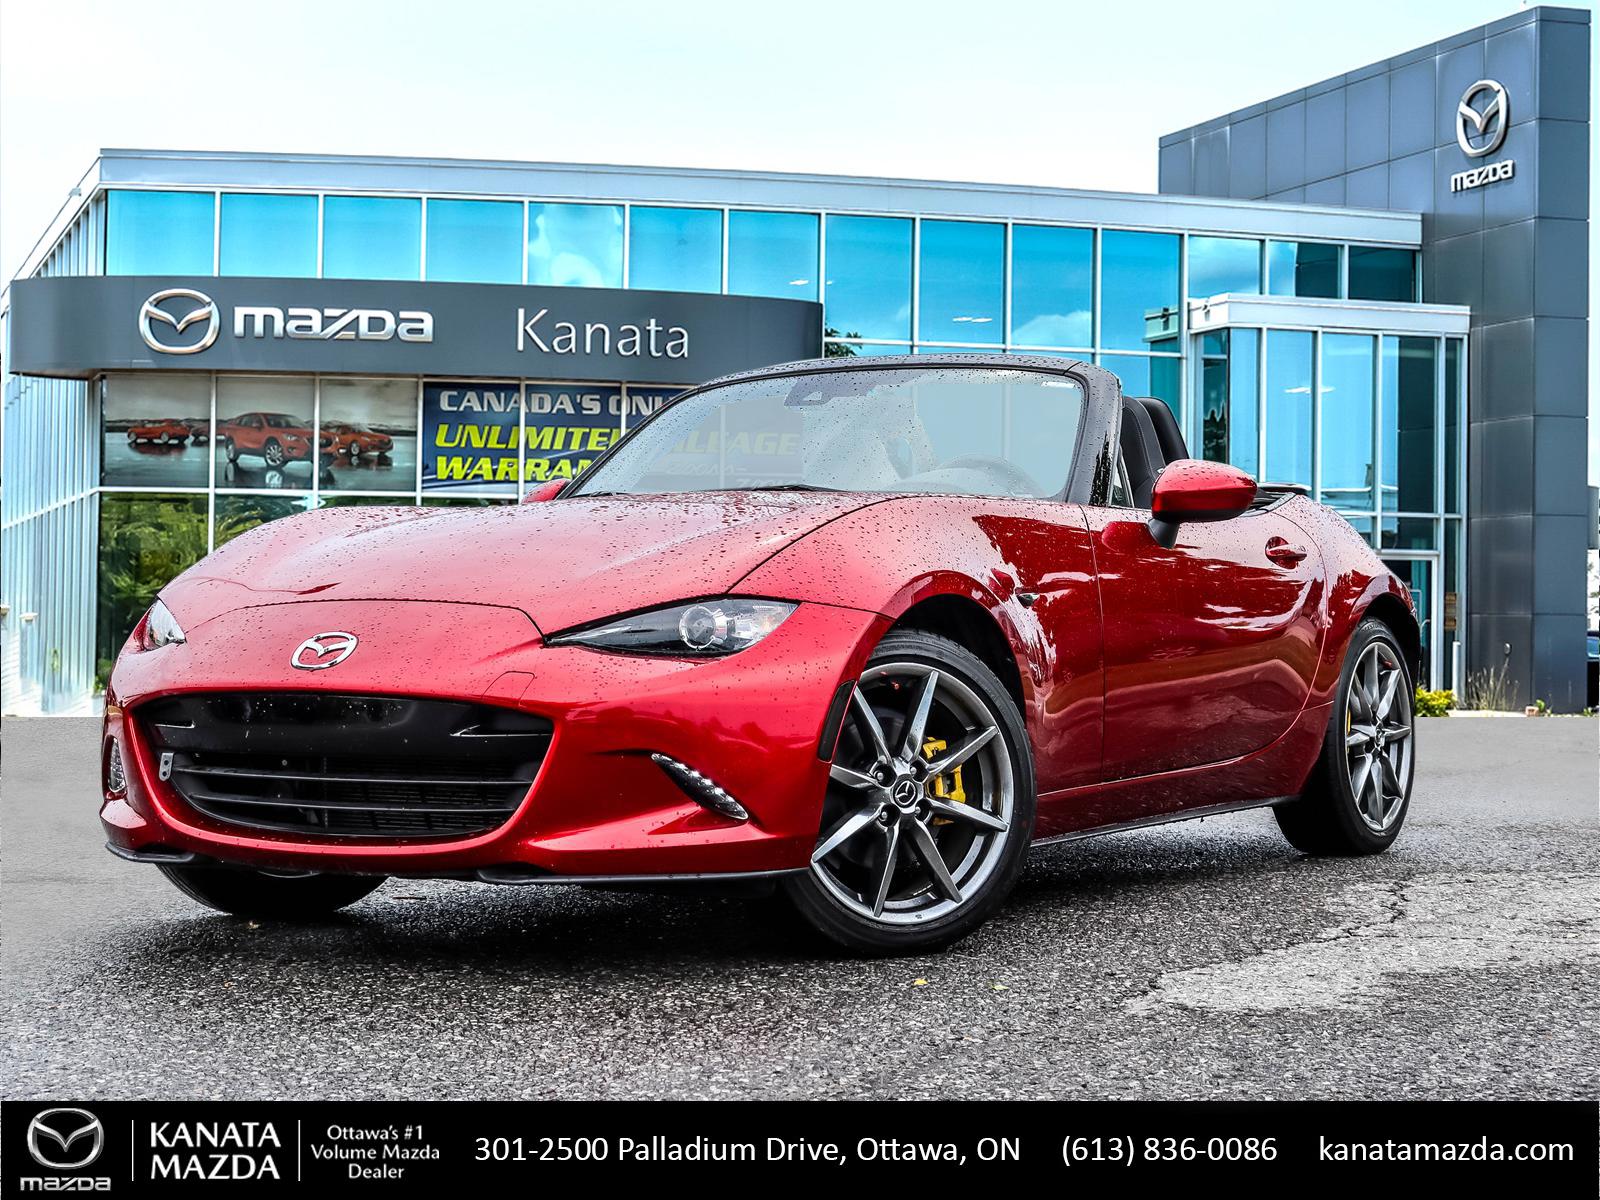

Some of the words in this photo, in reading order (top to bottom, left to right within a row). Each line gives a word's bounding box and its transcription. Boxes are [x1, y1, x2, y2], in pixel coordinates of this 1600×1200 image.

[1451, 160, 1514, 192] mazda
[234, 306, 433, 342] mazda
[517, 308, 689, 358] Kanata
[440, 391, 601, 415] CANADA'S
